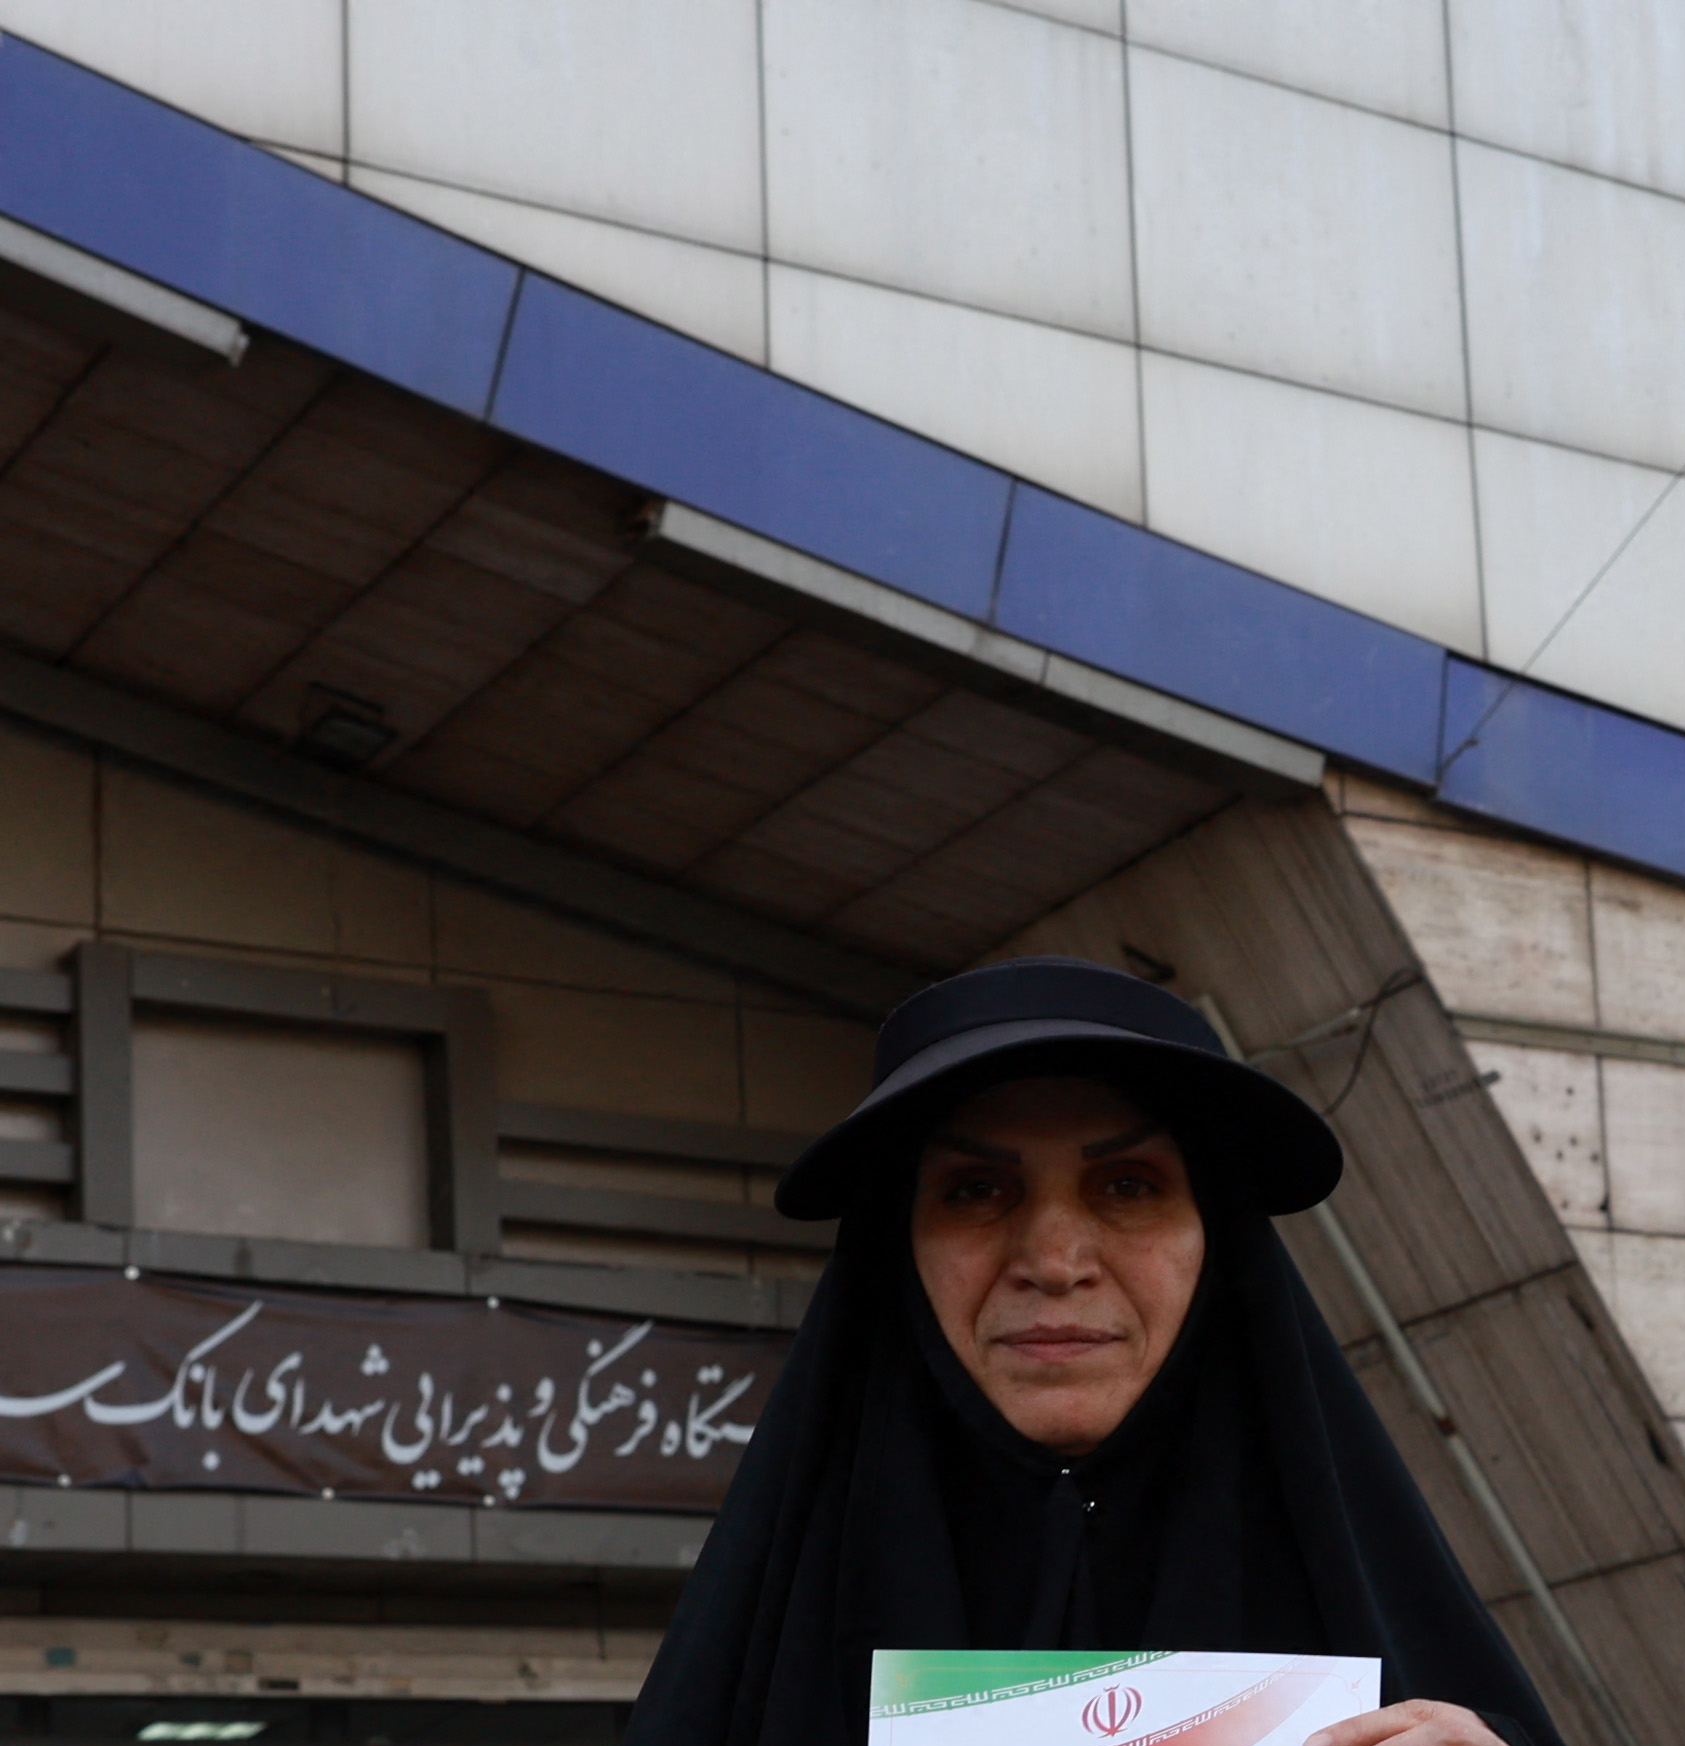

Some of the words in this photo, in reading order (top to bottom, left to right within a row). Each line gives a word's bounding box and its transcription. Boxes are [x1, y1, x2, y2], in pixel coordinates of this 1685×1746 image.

[83, 1299, 264, 1471] بانک
[232, 1343, 390, 1435] شهدای
[381, 1371, 526, 1500] پذیرایی
[528, 1376, 556, 1418] و
[537, 1320, 660, 1474] فرهنگی
